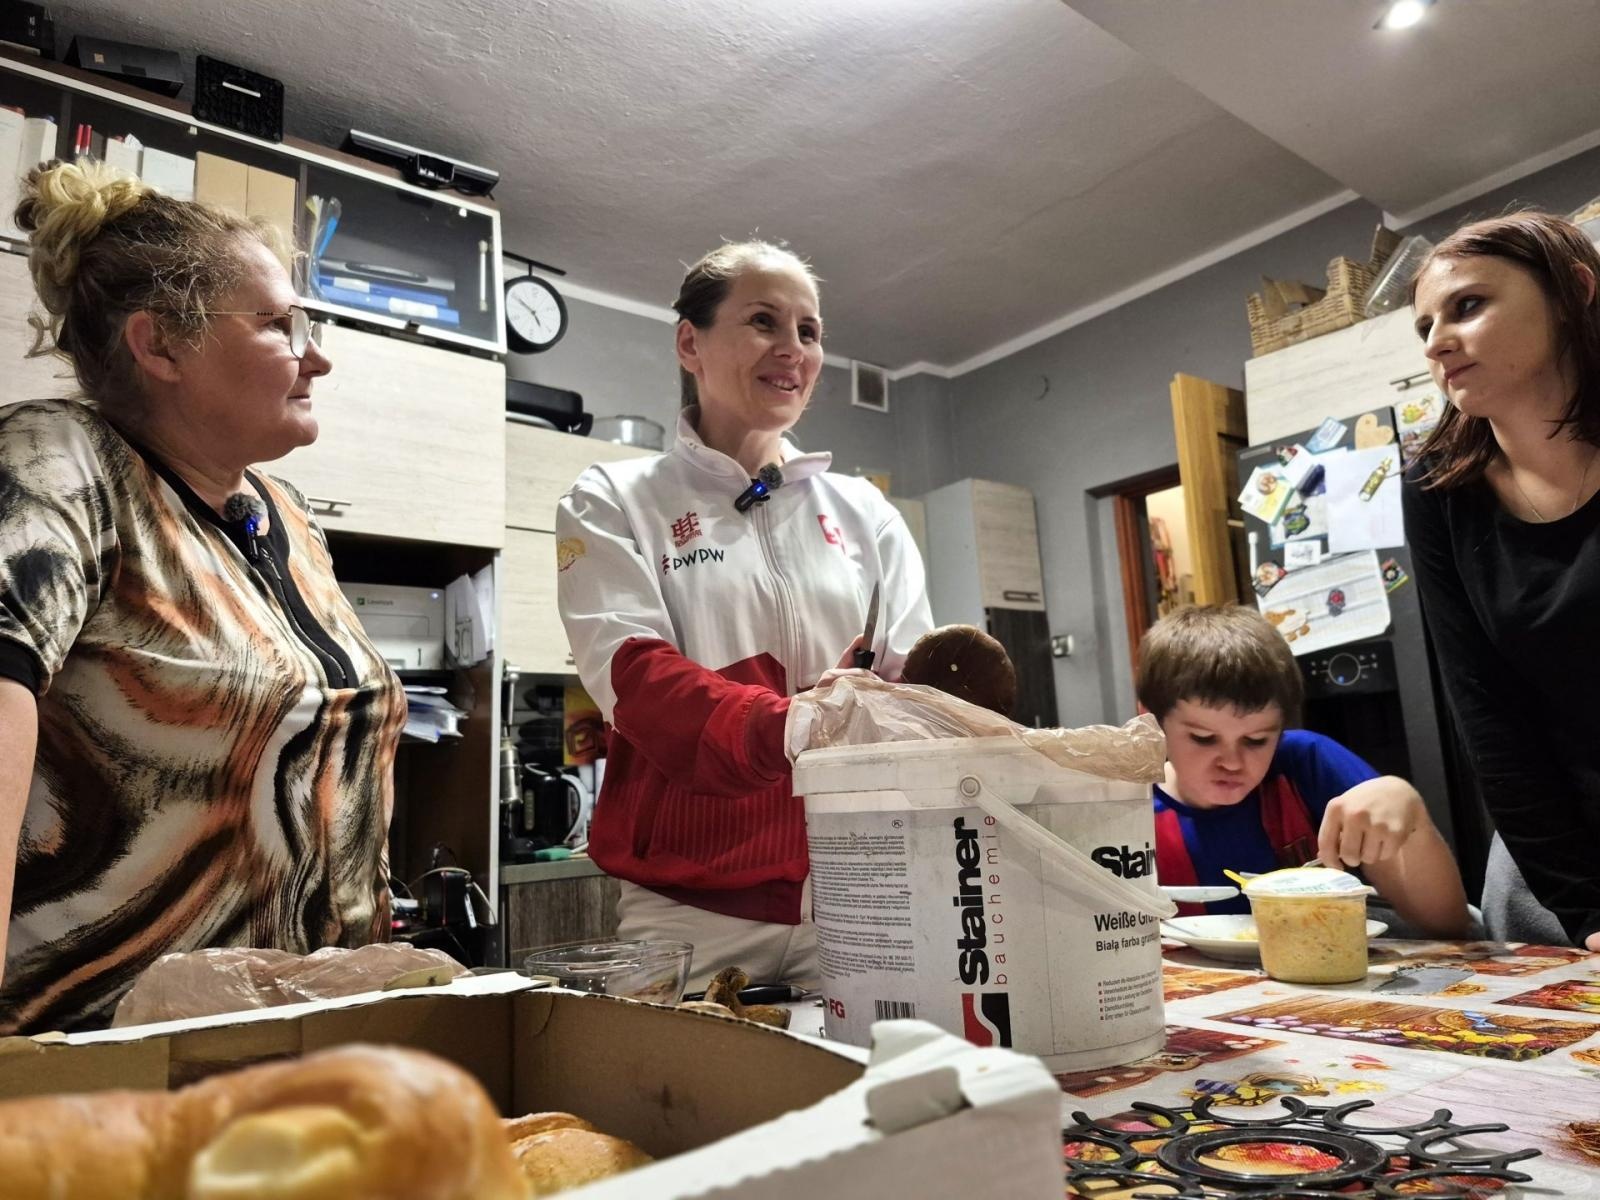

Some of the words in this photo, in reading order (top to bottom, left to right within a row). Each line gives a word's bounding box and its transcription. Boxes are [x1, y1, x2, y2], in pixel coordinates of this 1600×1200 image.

[673, 548, 724, 570] PWPW
[953, 817, 989, 985] Stainer
[982, 815, 1007, 985] bauchemie
[1094, 911, 1136, 932] Weiße
[1121, 936, 1140, 948] farba
[829, 999, 845, 1019] FG
